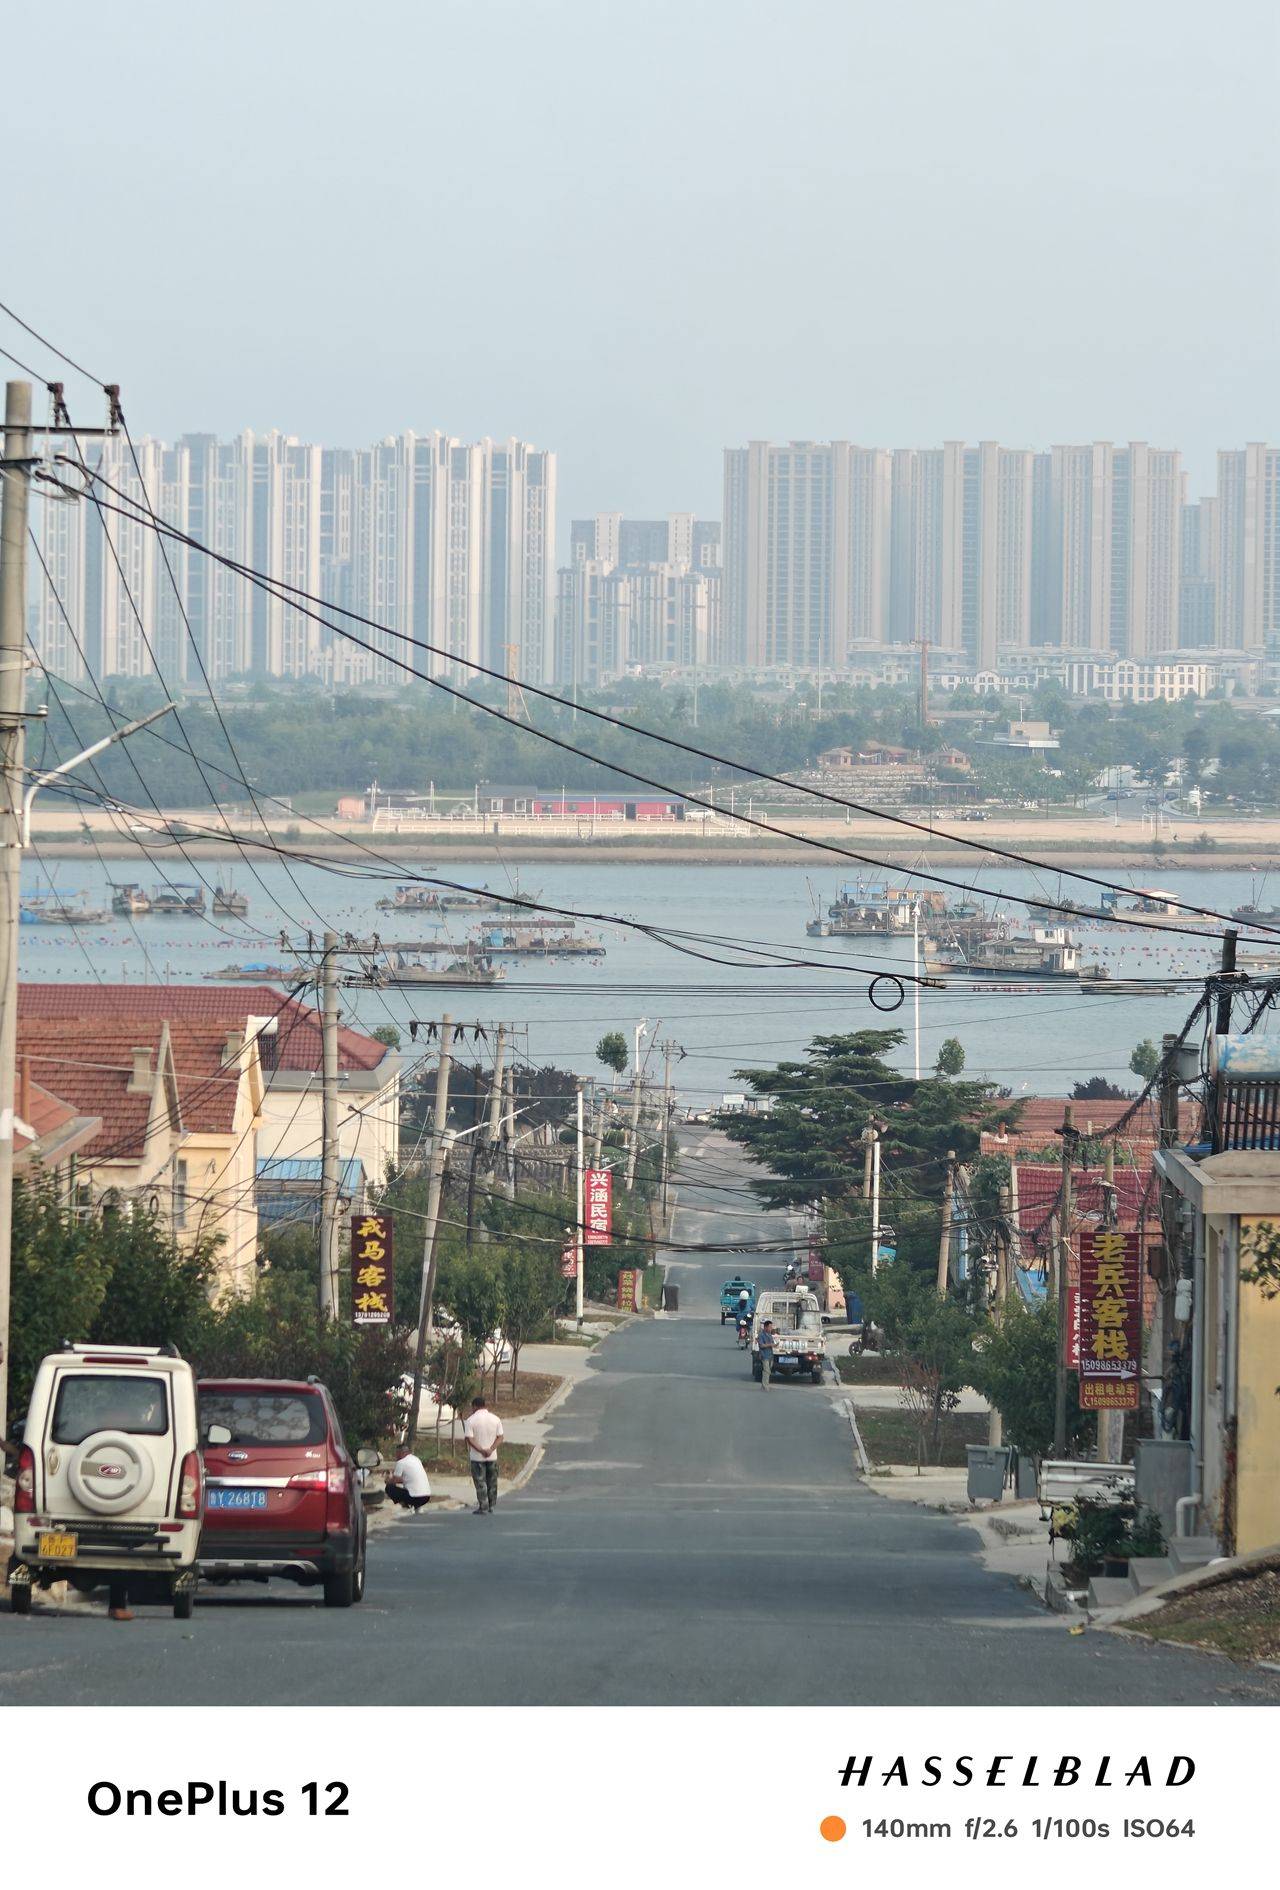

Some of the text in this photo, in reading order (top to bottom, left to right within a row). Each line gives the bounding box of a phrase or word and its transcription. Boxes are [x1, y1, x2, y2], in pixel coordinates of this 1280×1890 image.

[590, 1172, 608, 1233] 兴涵民宿
[355, 1217, 388, 1312] 戎马客栈
[1092, 1232, 1129, 1360] 老兵客栈
[1081, 1360, 1137, 1370] 15098653379
[1085, 1383, 1136, 1395] 出租电动车
